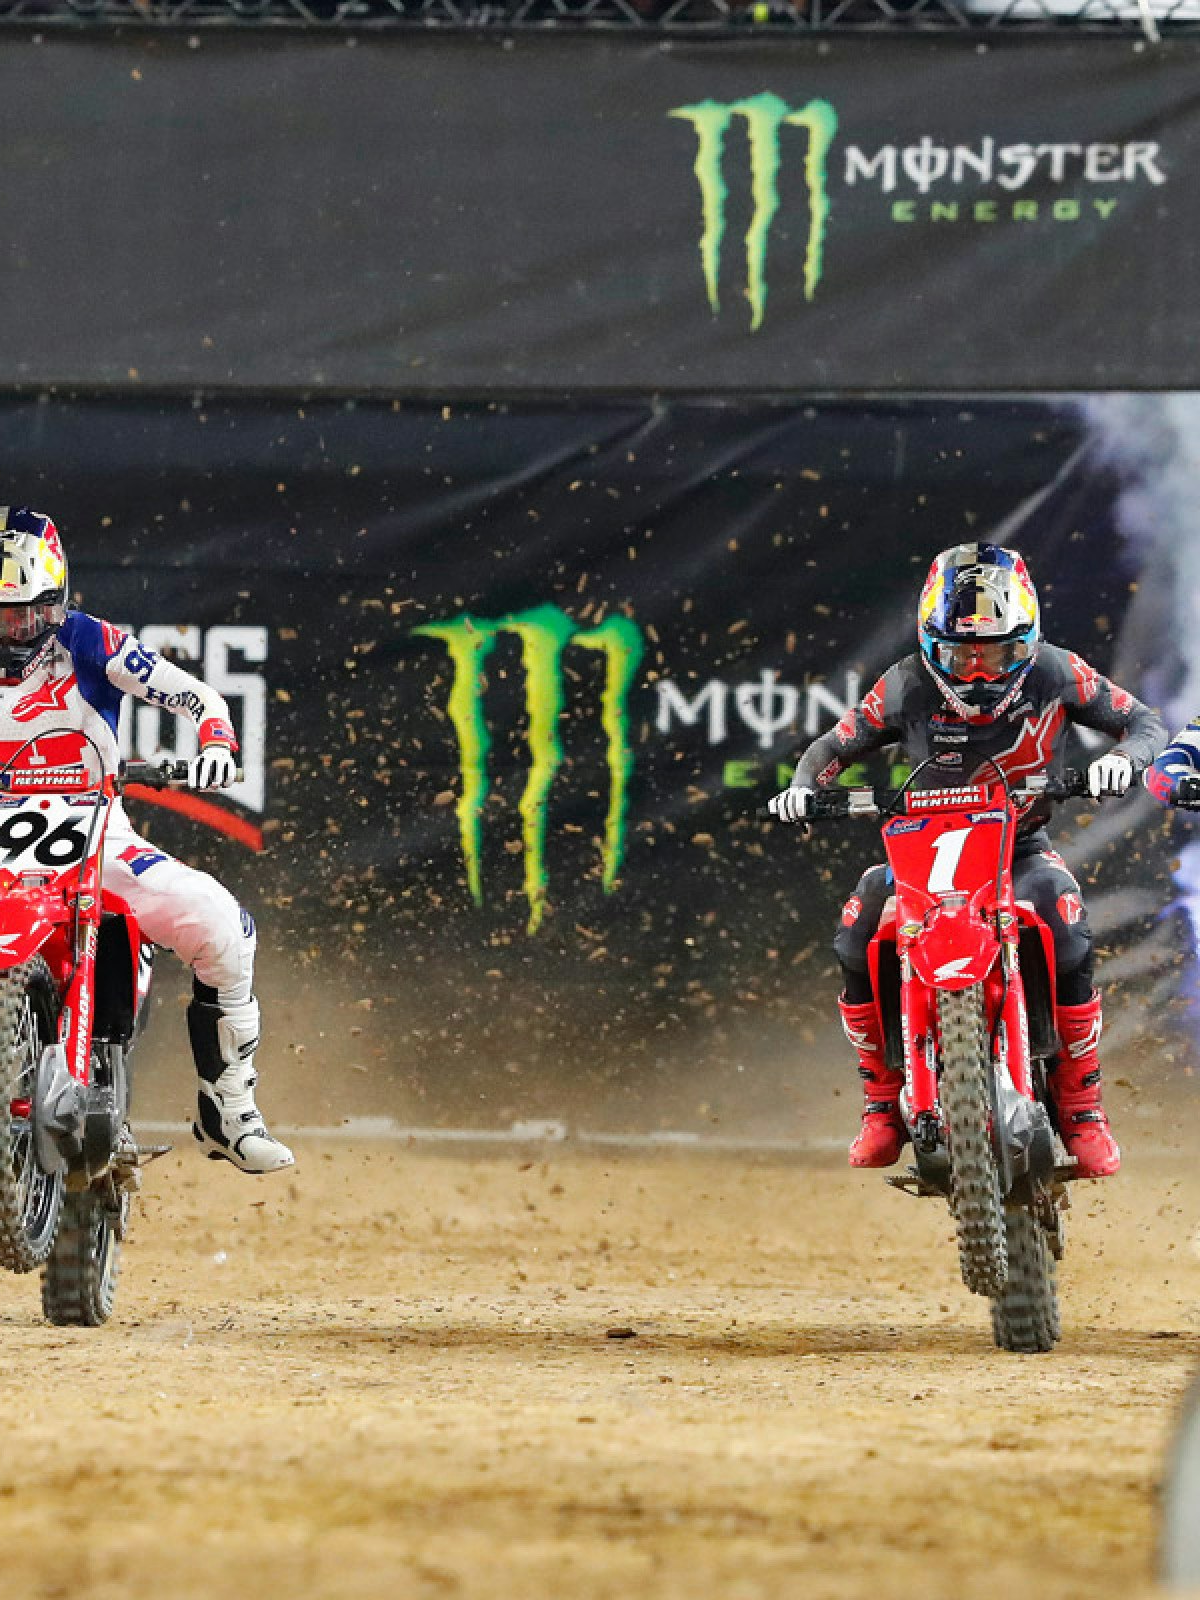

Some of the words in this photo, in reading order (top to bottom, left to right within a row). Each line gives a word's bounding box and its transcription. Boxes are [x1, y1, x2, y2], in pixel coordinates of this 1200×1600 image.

[844, 136, 1166, 192] MONSTER
[892, 199, 1118, 222] ENERGY
[14, 776, 82, 785] RENTHAL
[911, 794, 982, 808] RENTHAL
[927, 827, 973, 894] 1
[75, 984, 90, 1074] DUNLOP
